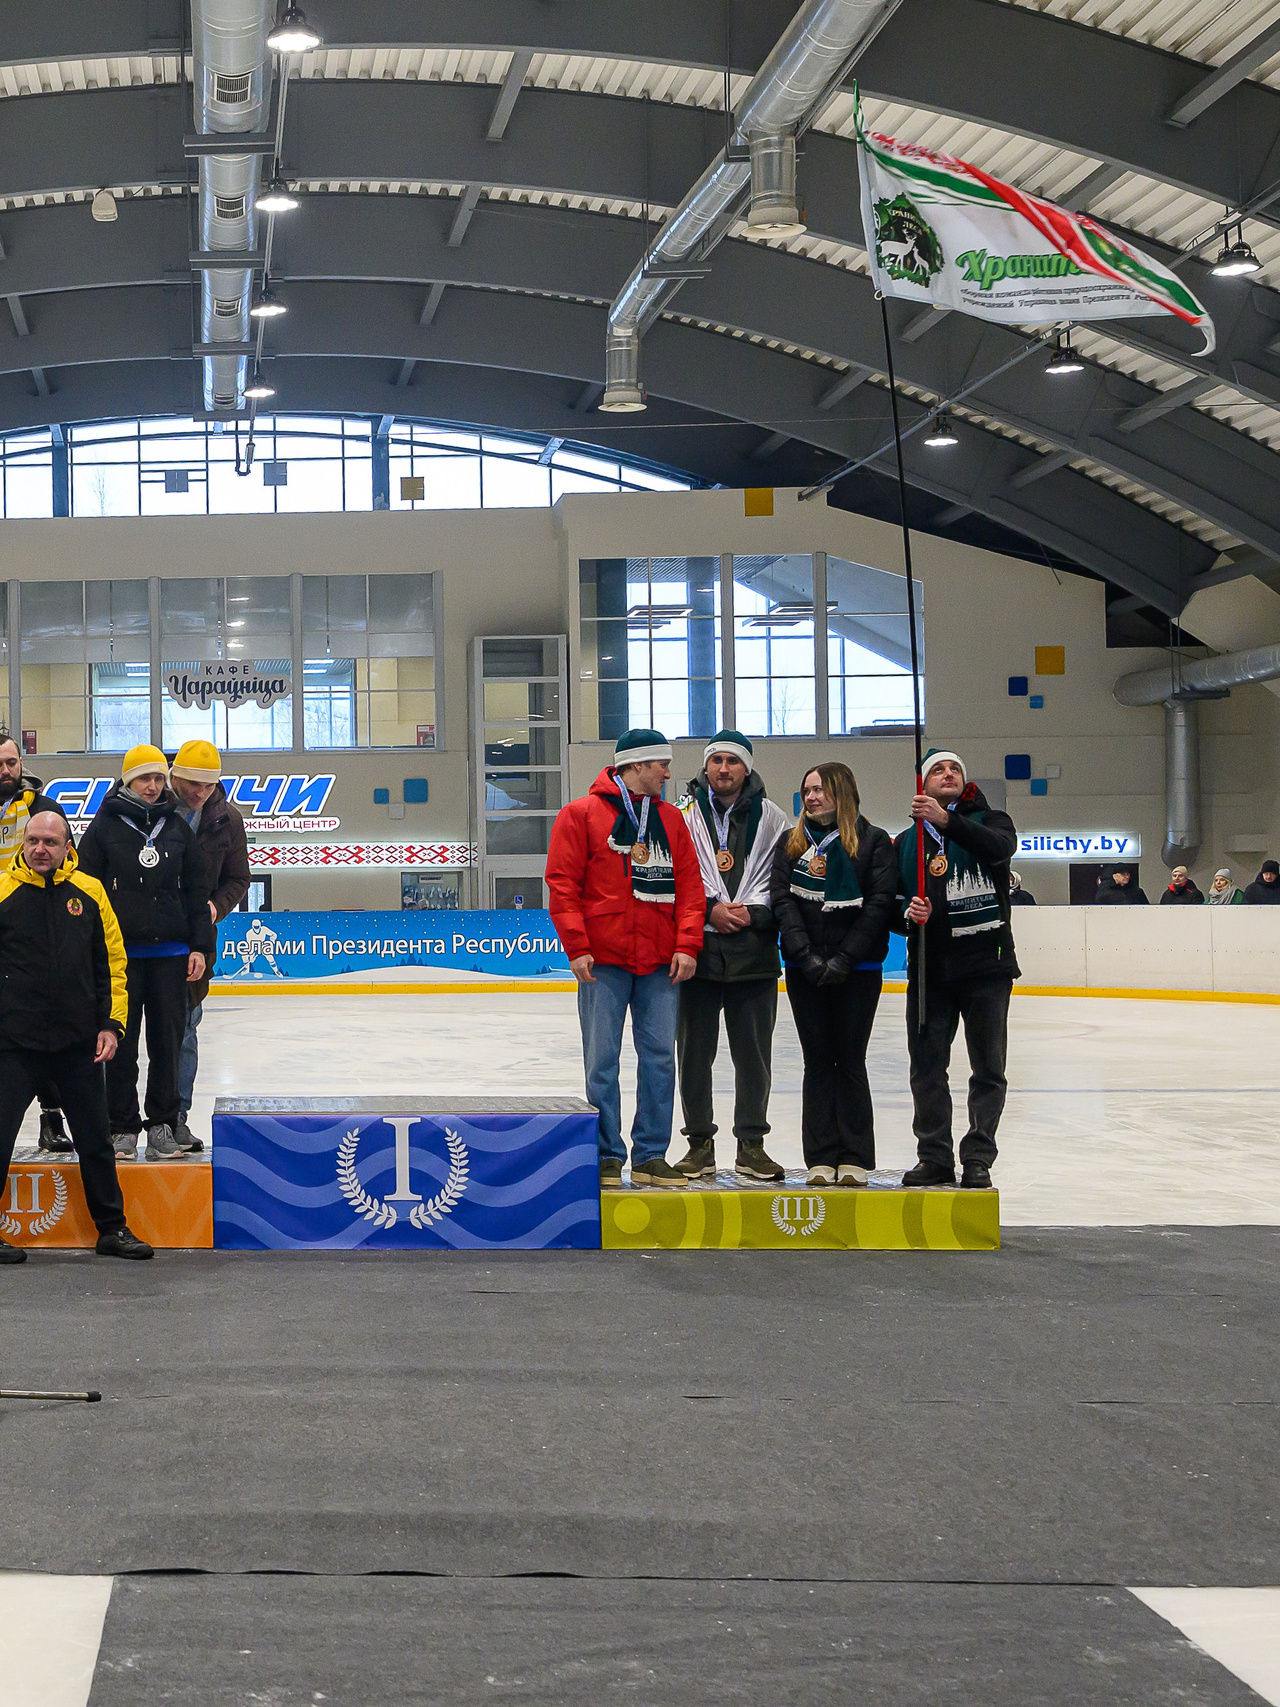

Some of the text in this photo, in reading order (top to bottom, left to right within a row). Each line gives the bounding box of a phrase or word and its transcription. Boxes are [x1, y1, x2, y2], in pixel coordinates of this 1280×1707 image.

[955, 248, 1082, 292] Хранит
[205, 665, 250, 675] КАФЕ
[293, 820, 337, 831] ЦЕНТР
[1021, 836, 1128, 853] silichy.by
[222, 939, 306, 959] делами
[311, 934, 446, 960] Президента
